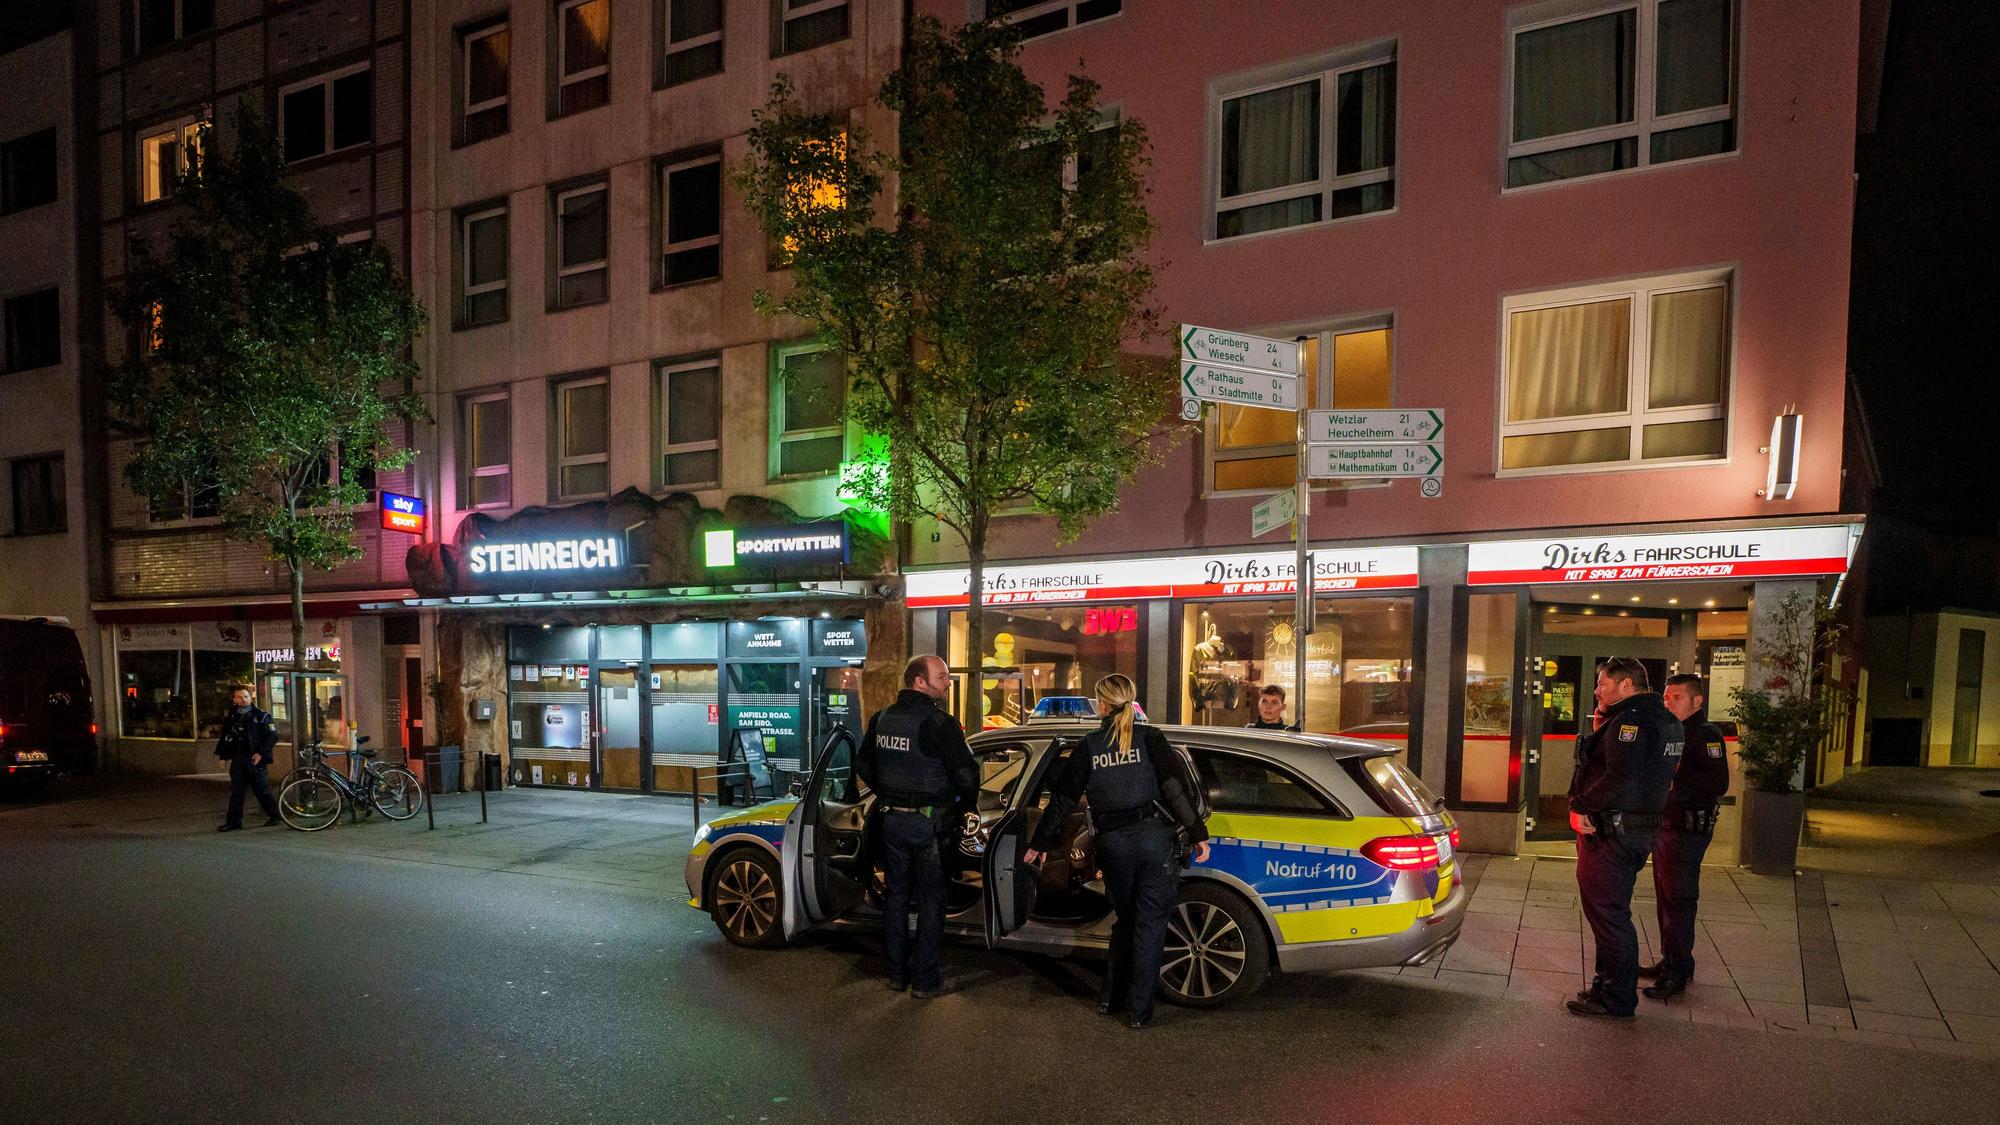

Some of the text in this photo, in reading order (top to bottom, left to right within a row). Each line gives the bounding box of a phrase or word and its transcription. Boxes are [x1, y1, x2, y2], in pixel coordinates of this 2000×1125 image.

[1208, 334, 1277, 353] Grünberg 24
[1208, 348, 1245, 363] Wieseck
[1208, 370, 1244, 385] Rathaus
[1218, 386, 1263, 401] Stadtmitte
[1328, 414, 1410, 424] Wetzlar 21
[1328, 428, 1394, 438] Heuchelheim
[1339, 449, 1393, 460] Hauptbahnhof
[1339, 463, 1397, 472] Mathematikum
[393, 498, 414, 514] sky
[392, 516, 416, 528] sport
[736, 535, 841, 554] SPORTWETTEN
[470, 538, 618, 573] STEINREICH
[1541, 542, 1761, 571] Dirks FAHRSCHULE
[1204, 559, 1379, 585] Dirks FASCHULE
[1564, 568, 1585, 580] MIT
[1620, 567, 1644, 578] ZUM
[1646, 565, 1734, 577] FÜHRERSCHEIN
[1022, 574, 1104, 588] FAHRSCHULE
[1223, 582, 1239, 593] MIT
[1266, 581, 1287, 592] ZUM
[823, 638, 855, 646] WETTEN
[826, 631, 851, 639] SPORT
[747, 640, 782, 648] ANNAHME
[739, 711, 792, 719] ANFIELD ROAD.
[738, 719, 772, 727] SAN SIRO.
[876, 734, 910, 751] POLIZEI
[1092, 748, 1141, 770] POLIZEI
[1266, 860, 1357, 880] Notruf 110
